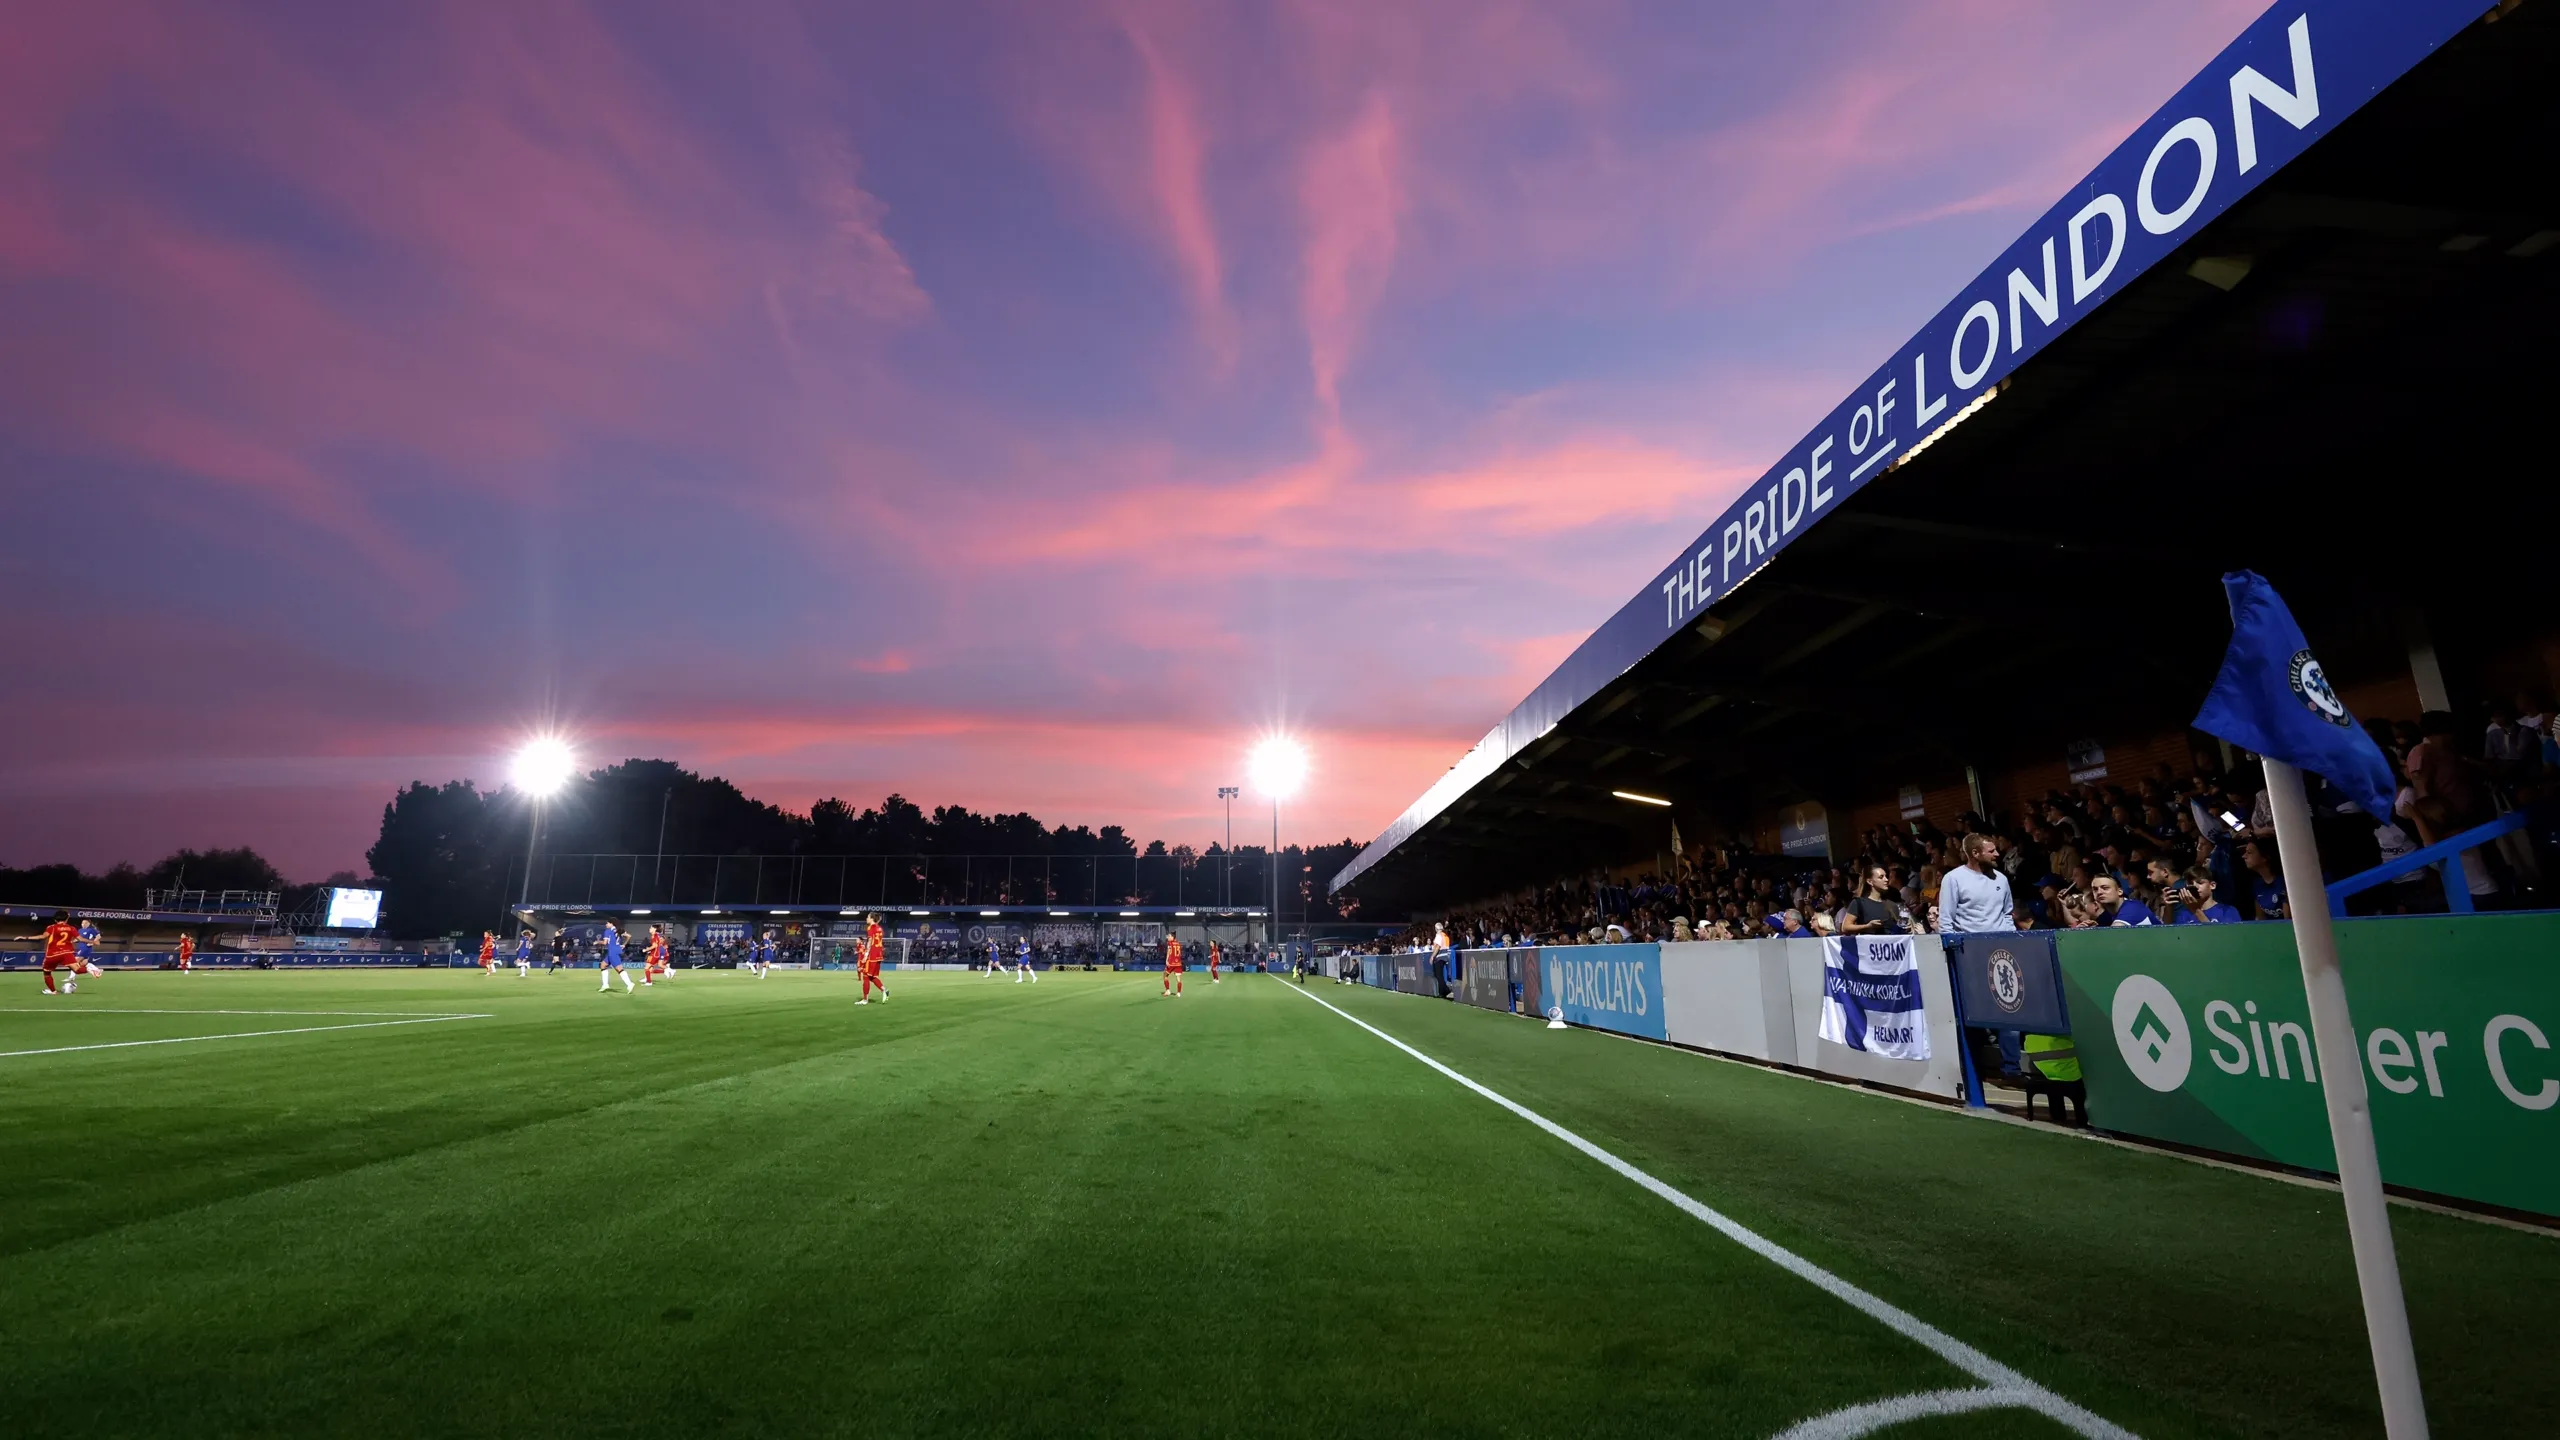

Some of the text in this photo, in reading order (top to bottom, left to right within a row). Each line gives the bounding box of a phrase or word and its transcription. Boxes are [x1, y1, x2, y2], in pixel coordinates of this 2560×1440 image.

[1663, 12, 2320, 628] THE PRIDE OF LONDON
[2290, 650, 2314, 693] CHELSEA
[1790, 838, 1803, 848] PRIDE
[1808, 834, 1827, 845] LONDON
[105, 911, 136, 920] FOOTBALL
[56, 932, 69, 946] 2
[1173, 945, 1181, 957] 13
[1869, 943, 1906, 961] SUOMI
[1990, 951, 2014, 965] CHELSEA
[1565, 960, 1647, 1016] BARCLAYS
[2204, 999, 2448, 1098] Siner
